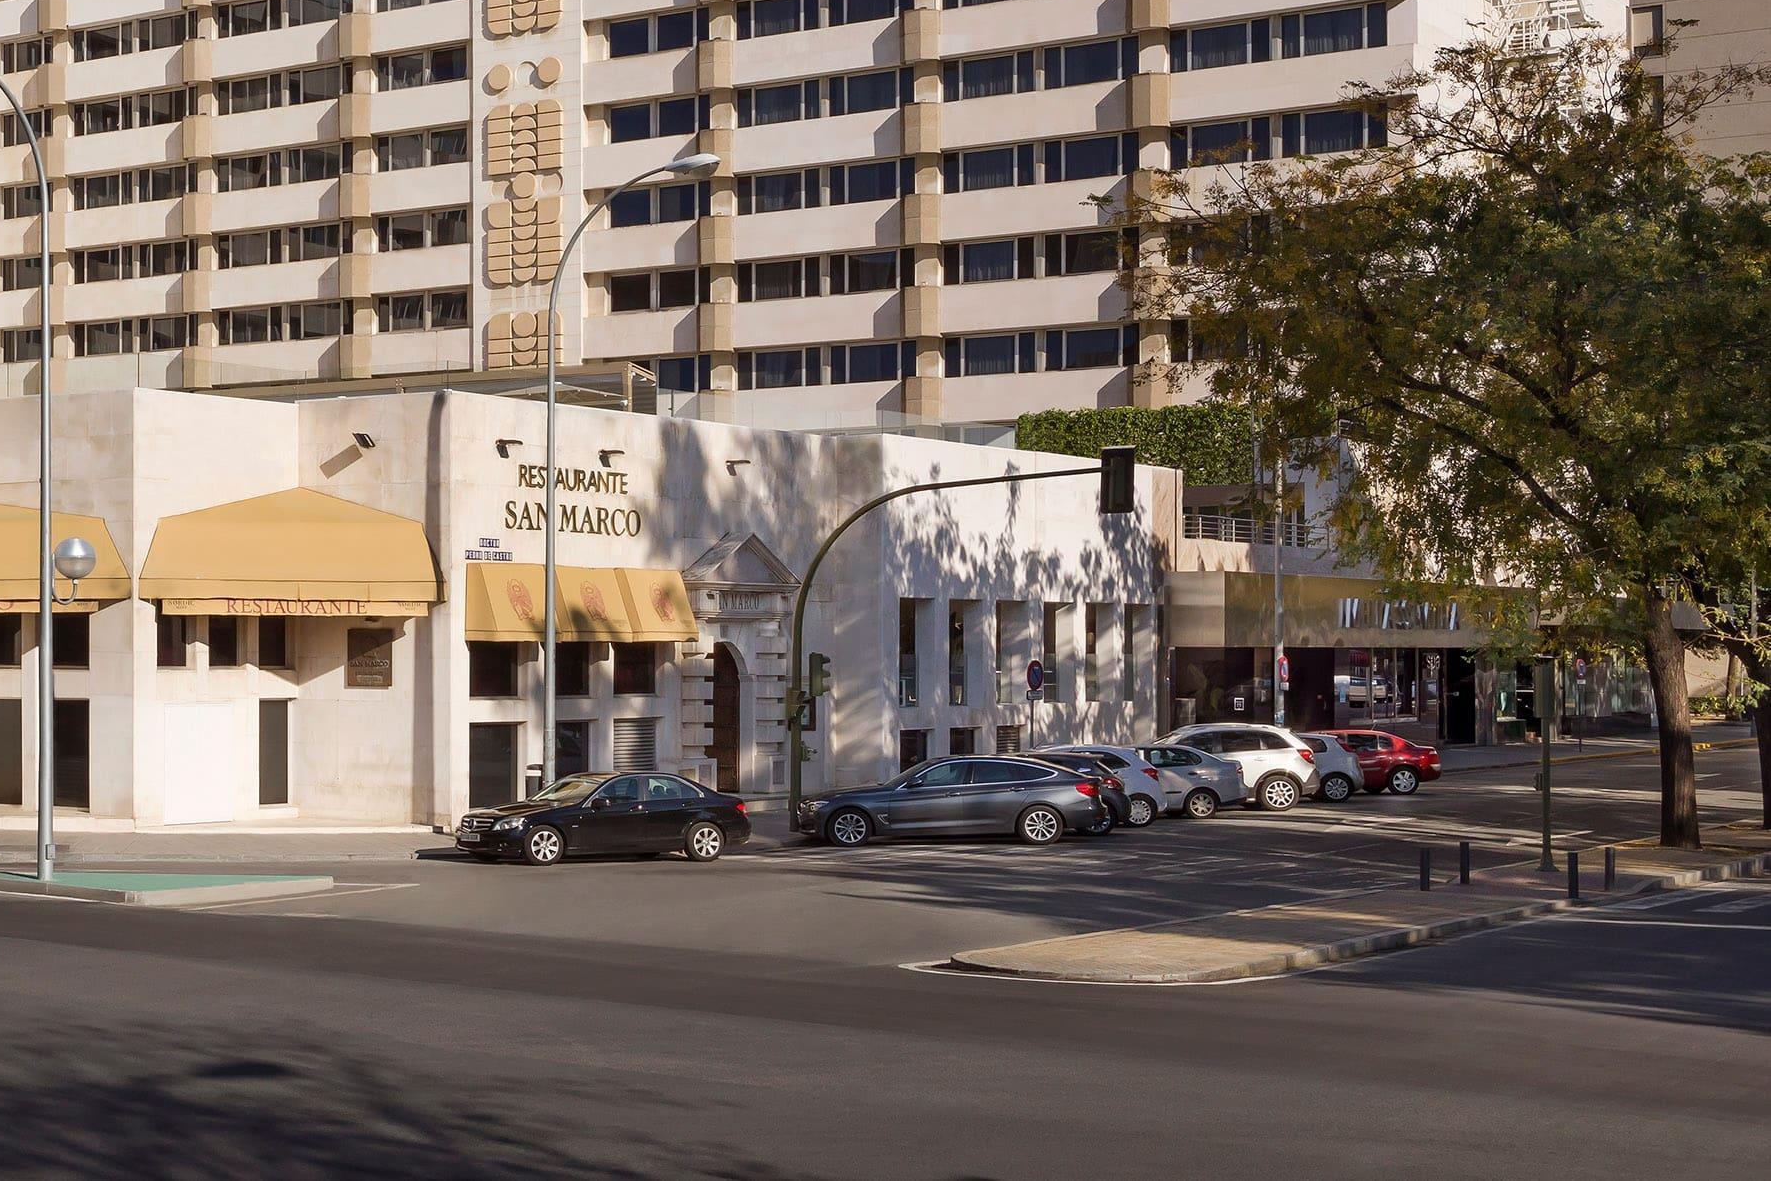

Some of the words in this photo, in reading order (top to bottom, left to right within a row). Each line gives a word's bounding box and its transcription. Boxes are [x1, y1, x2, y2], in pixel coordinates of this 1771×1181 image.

[518, 464, 628, 495] RESAURANTE
[558, 504, 641, 537] MARCO
[228, 599, 367, 615] RESTAURANTE
[731, 592, 760, 610] MARCO
